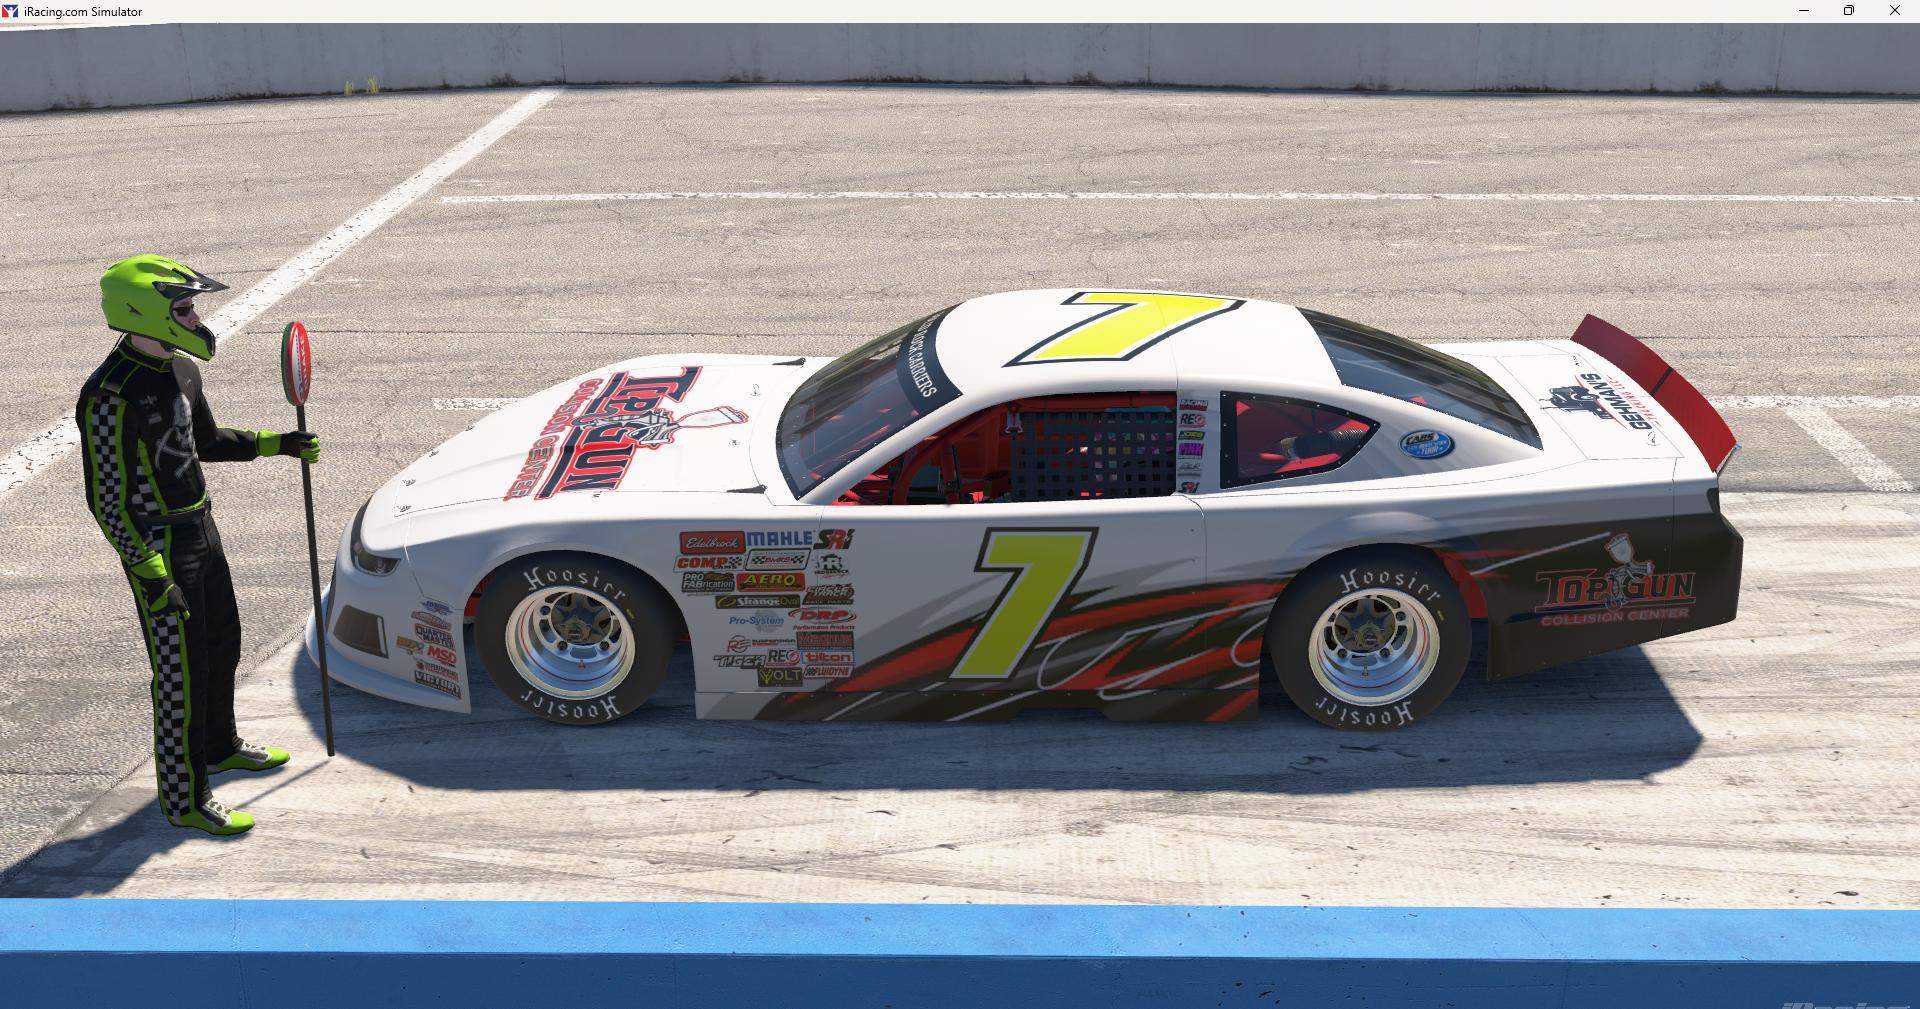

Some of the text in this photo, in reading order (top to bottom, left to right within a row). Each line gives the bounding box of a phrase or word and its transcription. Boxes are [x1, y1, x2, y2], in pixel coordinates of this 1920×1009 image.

[24, 6, 143, 19] iRacing.com Simulator
[1000, 291, 1247, 367] 7
[909, 352, 938, 398] CARRIERS
[503, 377, 604, 501] COLLISION CENTER
[560, 365, 703, 493] TOP GUN
[686, 537, 739, 549] Edelbrock
[747, 531, 813, 546] MAHLE
[678, 556, 729, 569] COMP
[523, 566, 626, 601] Hoosier
[684, 573, 704, 581] PRO
[744, 574, 796, 586] AERO
[1340, 568, 1441, 601] Hoosier
[1535, 569, 1697, 606] TOP GUN
[948, 526, 1100, 682] 7
[800, 610, 849, 621] DRP
[1541, 607, 1690, 627] COLLISION CENTER
[427, 645, 457, 664] MSD
[806, 653, 850, 662] tilton
[760, 669, 800, 685] VOLT
[521, 690, 621, 720] Hoosier
[1315, 697, 1414, 727] Hoosier
